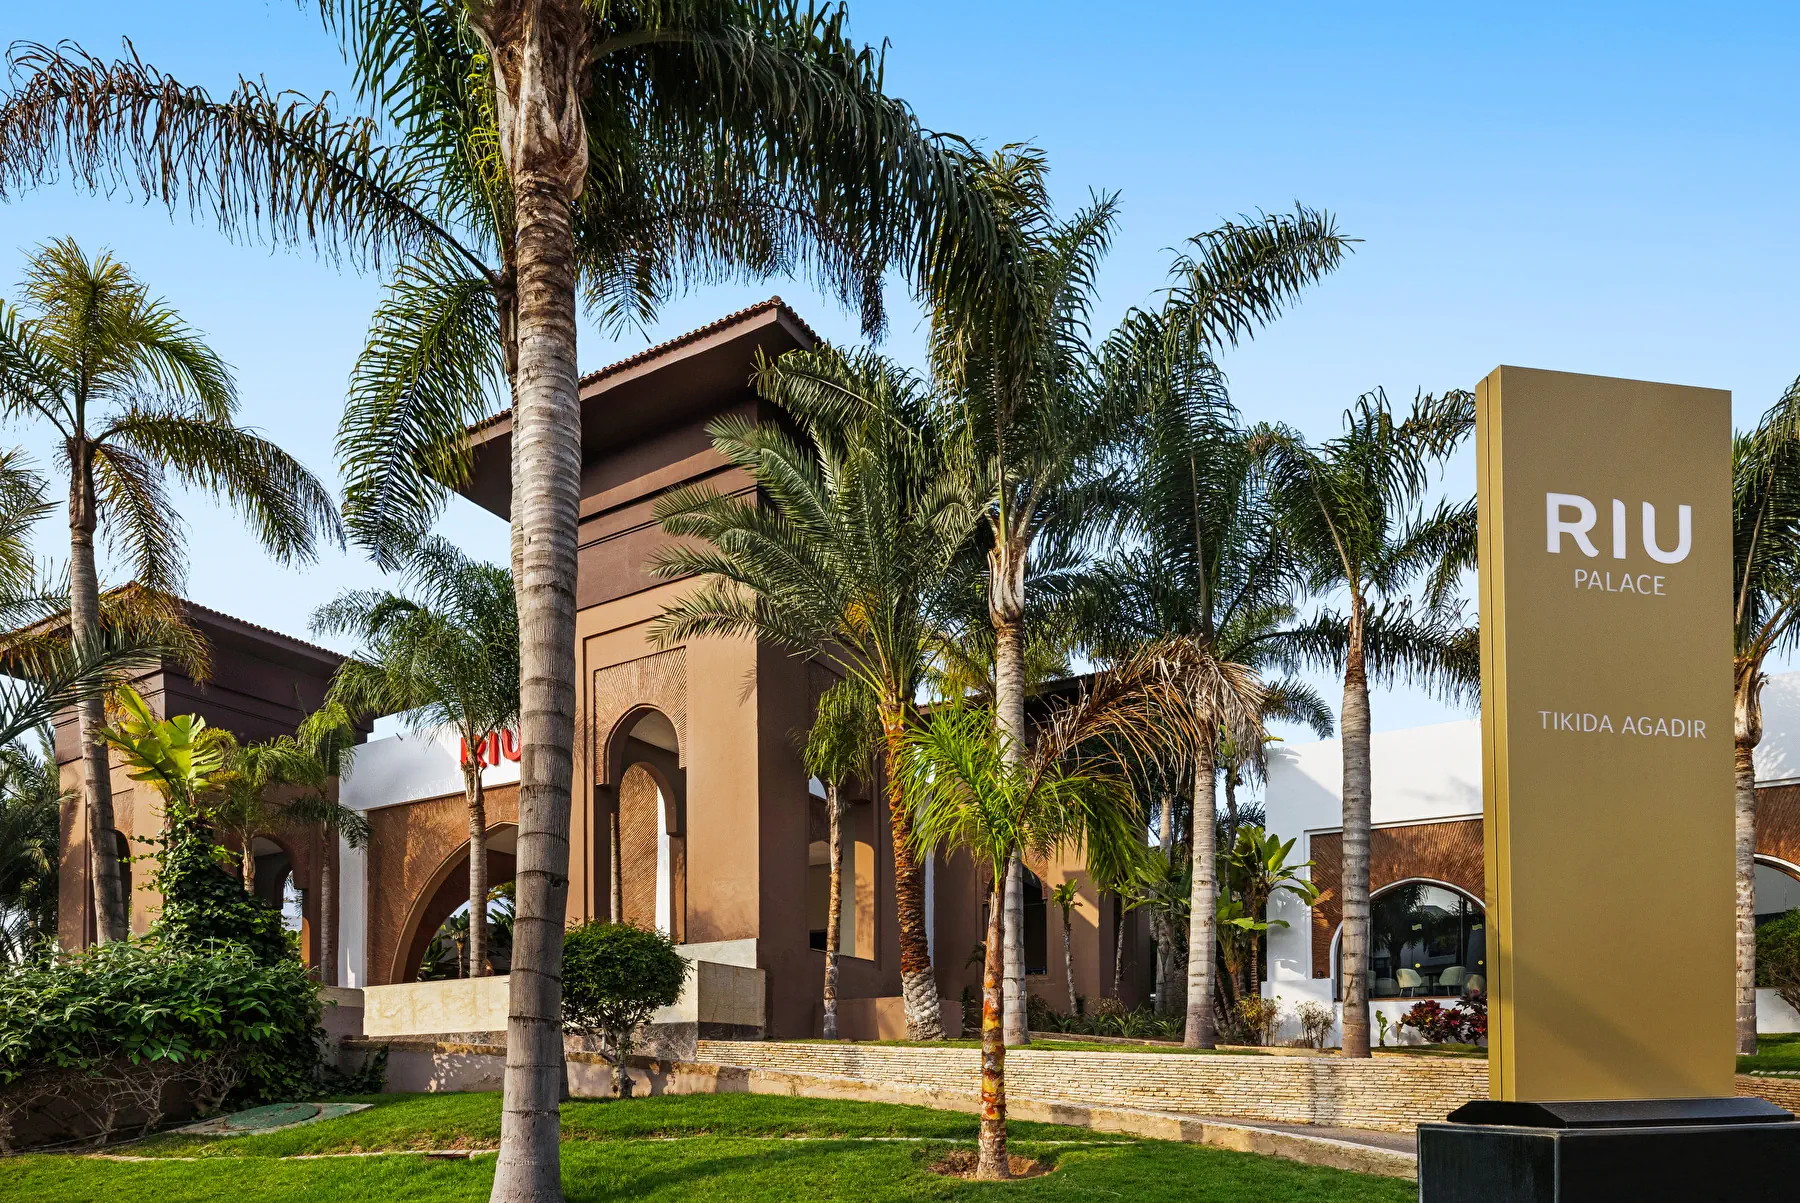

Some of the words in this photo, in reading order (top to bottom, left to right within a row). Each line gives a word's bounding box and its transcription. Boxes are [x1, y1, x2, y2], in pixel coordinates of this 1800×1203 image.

[1546, 492, 1692, 564] RIU
[1574, 568, 1666, 596] PALACE
[1537, 710, 1614, 734] TIKIDA
[1621, 715, 1707, 739] AGADIR
